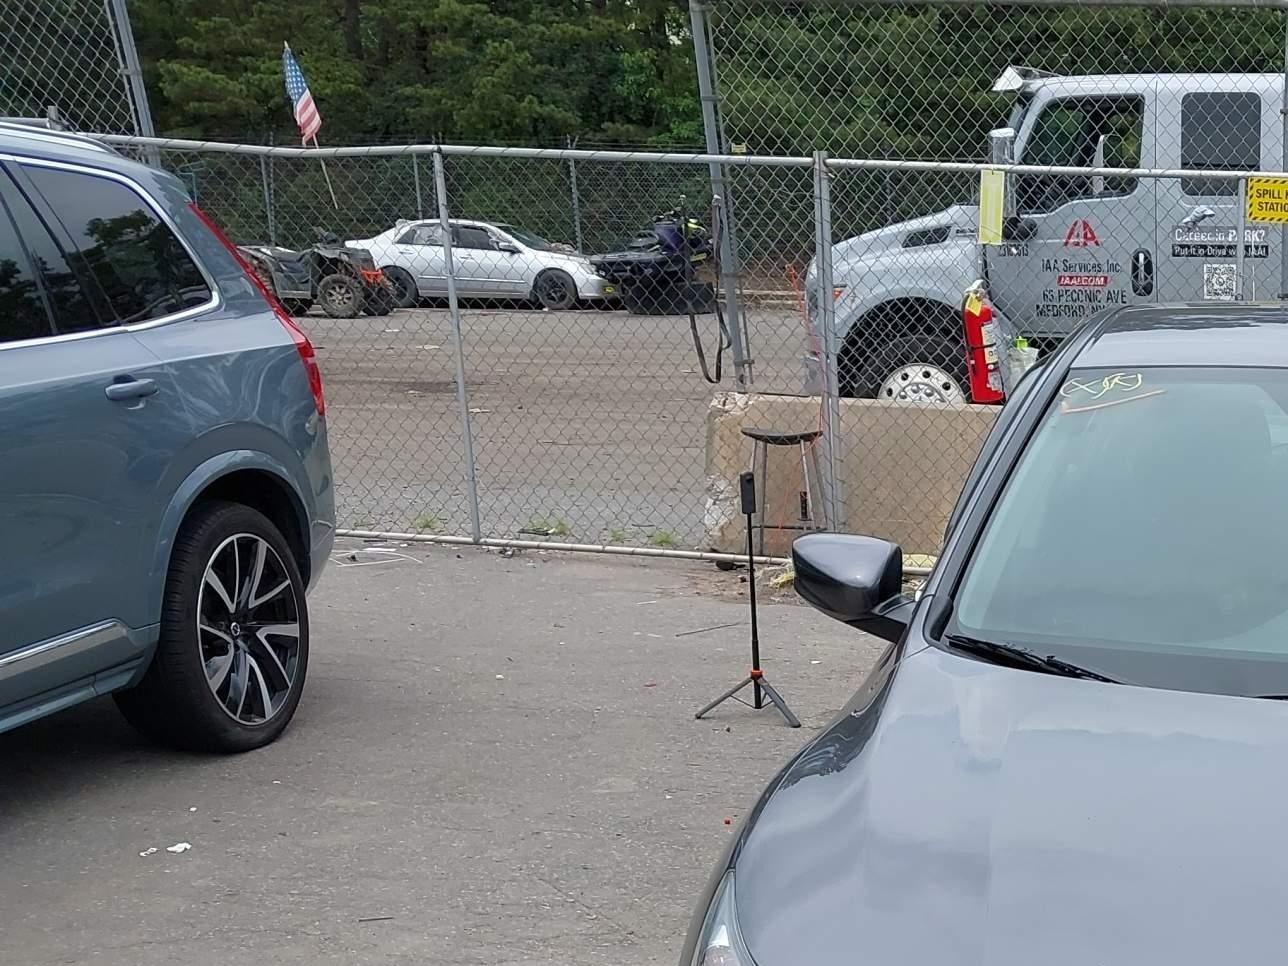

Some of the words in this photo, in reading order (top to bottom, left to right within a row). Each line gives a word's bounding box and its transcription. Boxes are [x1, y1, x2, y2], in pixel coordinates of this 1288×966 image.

[1255, 188, 1282, 200] SPILL
[1228, 229, 1266, 242] PRK?
[1105, 289, 1128, 304] AVE
